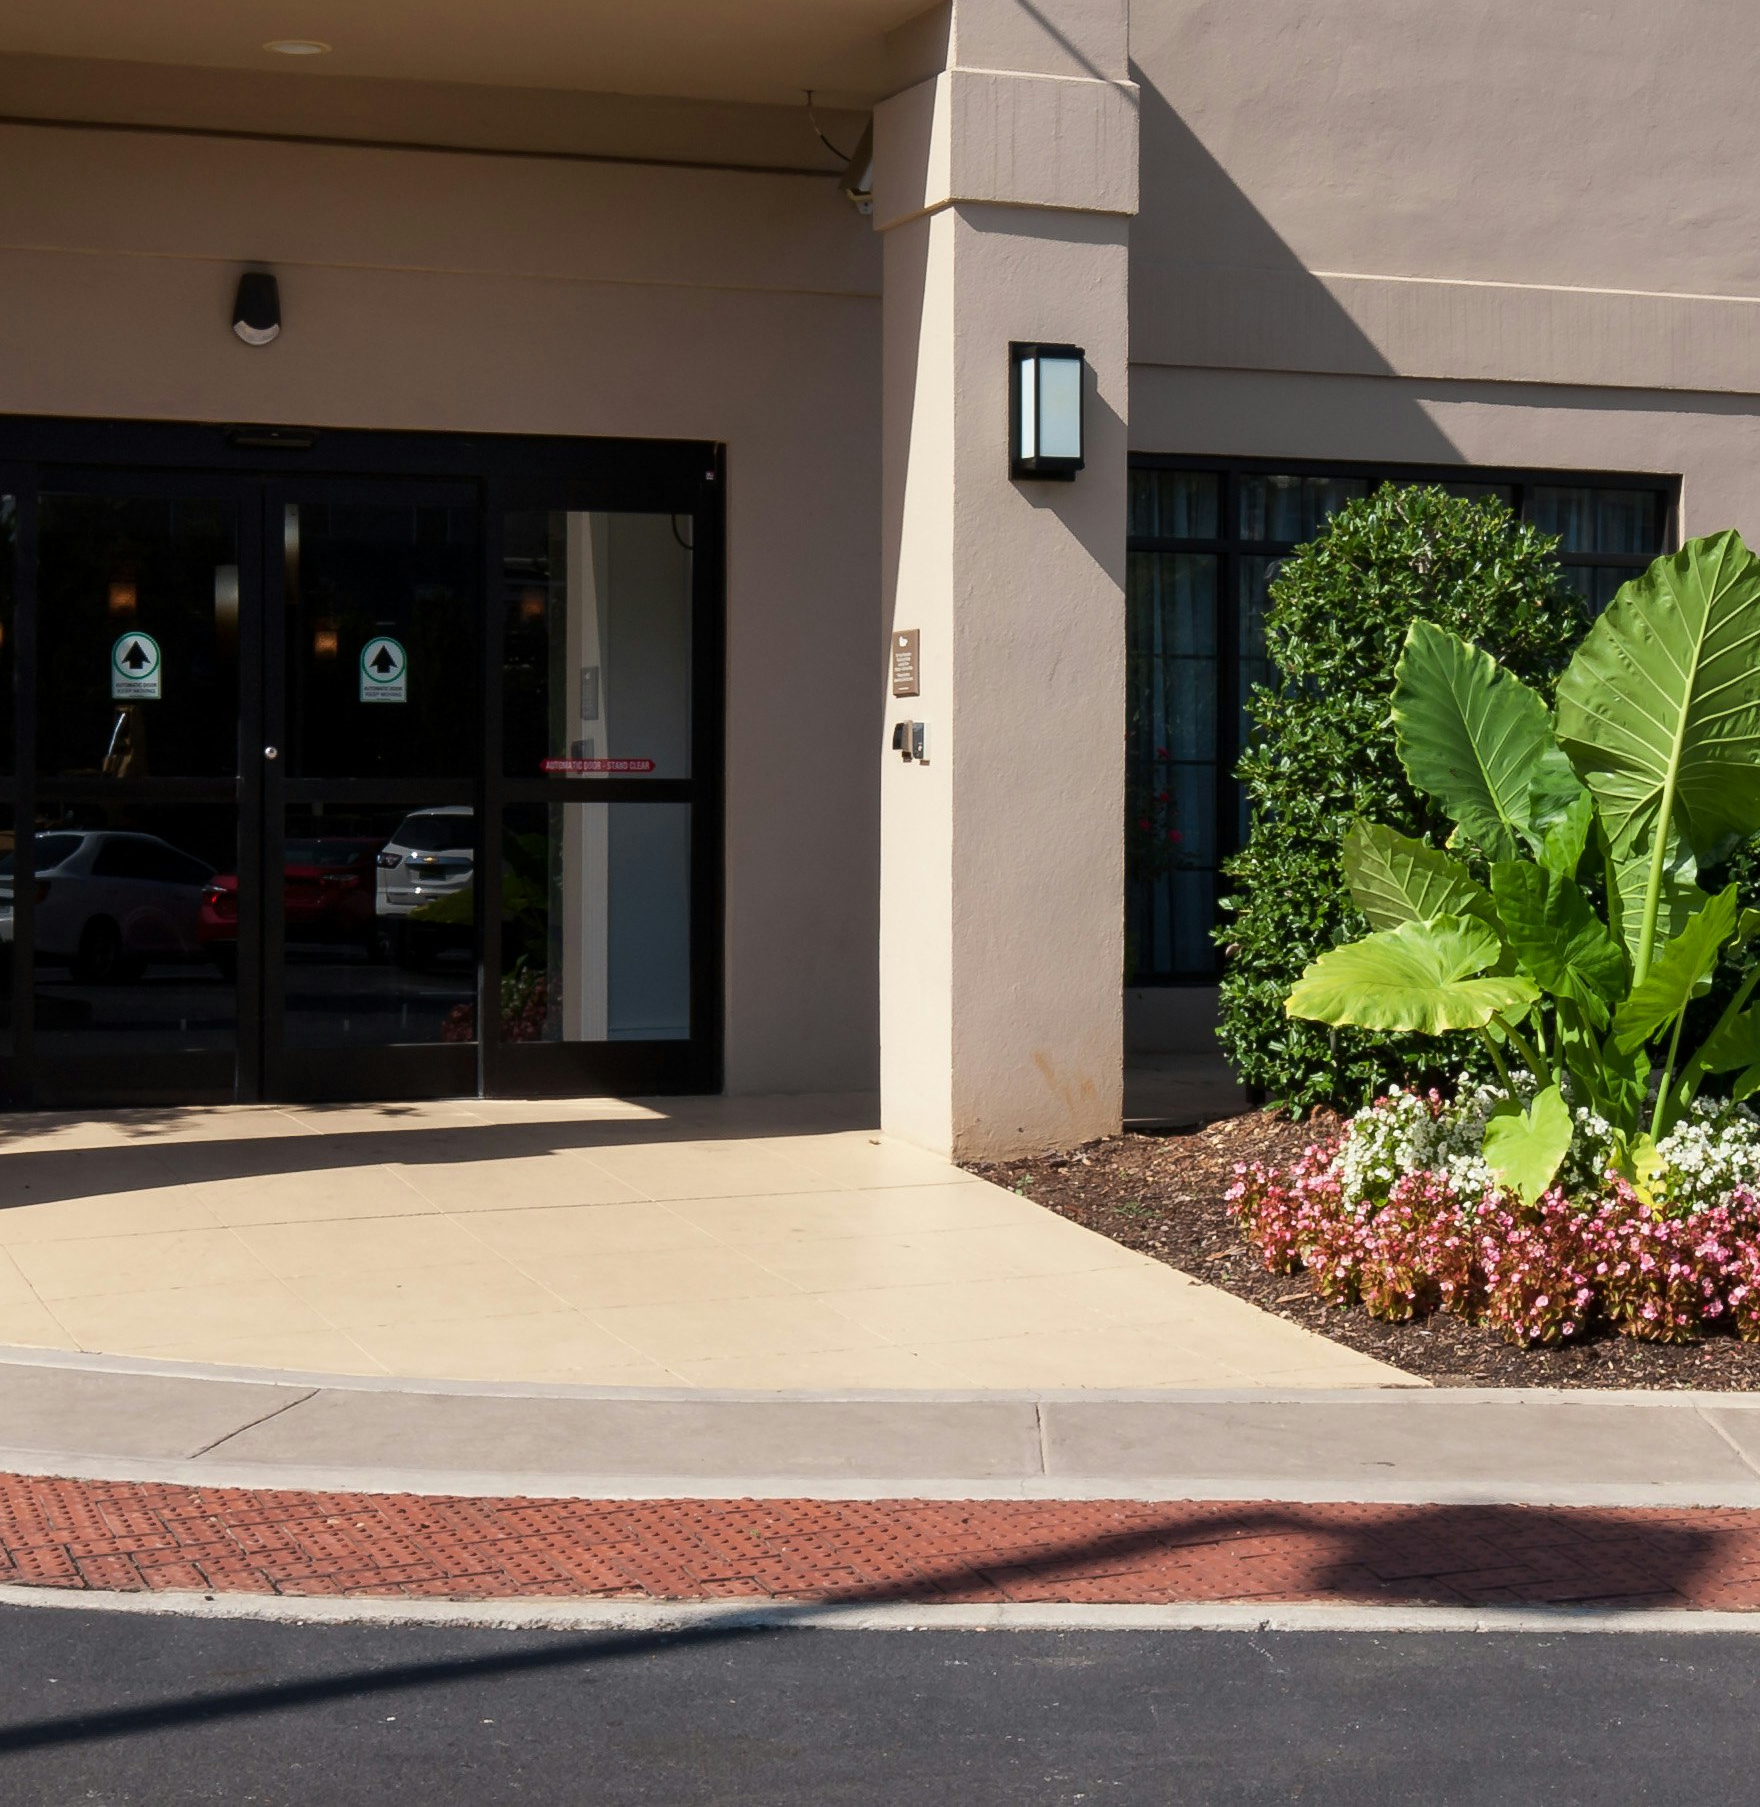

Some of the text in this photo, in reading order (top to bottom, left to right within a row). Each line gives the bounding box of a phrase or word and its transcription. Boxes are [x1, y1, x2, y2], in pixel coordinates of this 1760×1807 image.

[545, 761, 582, 770] AUTOMATIC
[583, 761, 601, 770] DOOR
[607, 761, 628, 770] STAND
[629, 761, 650, 770] CLEAR
